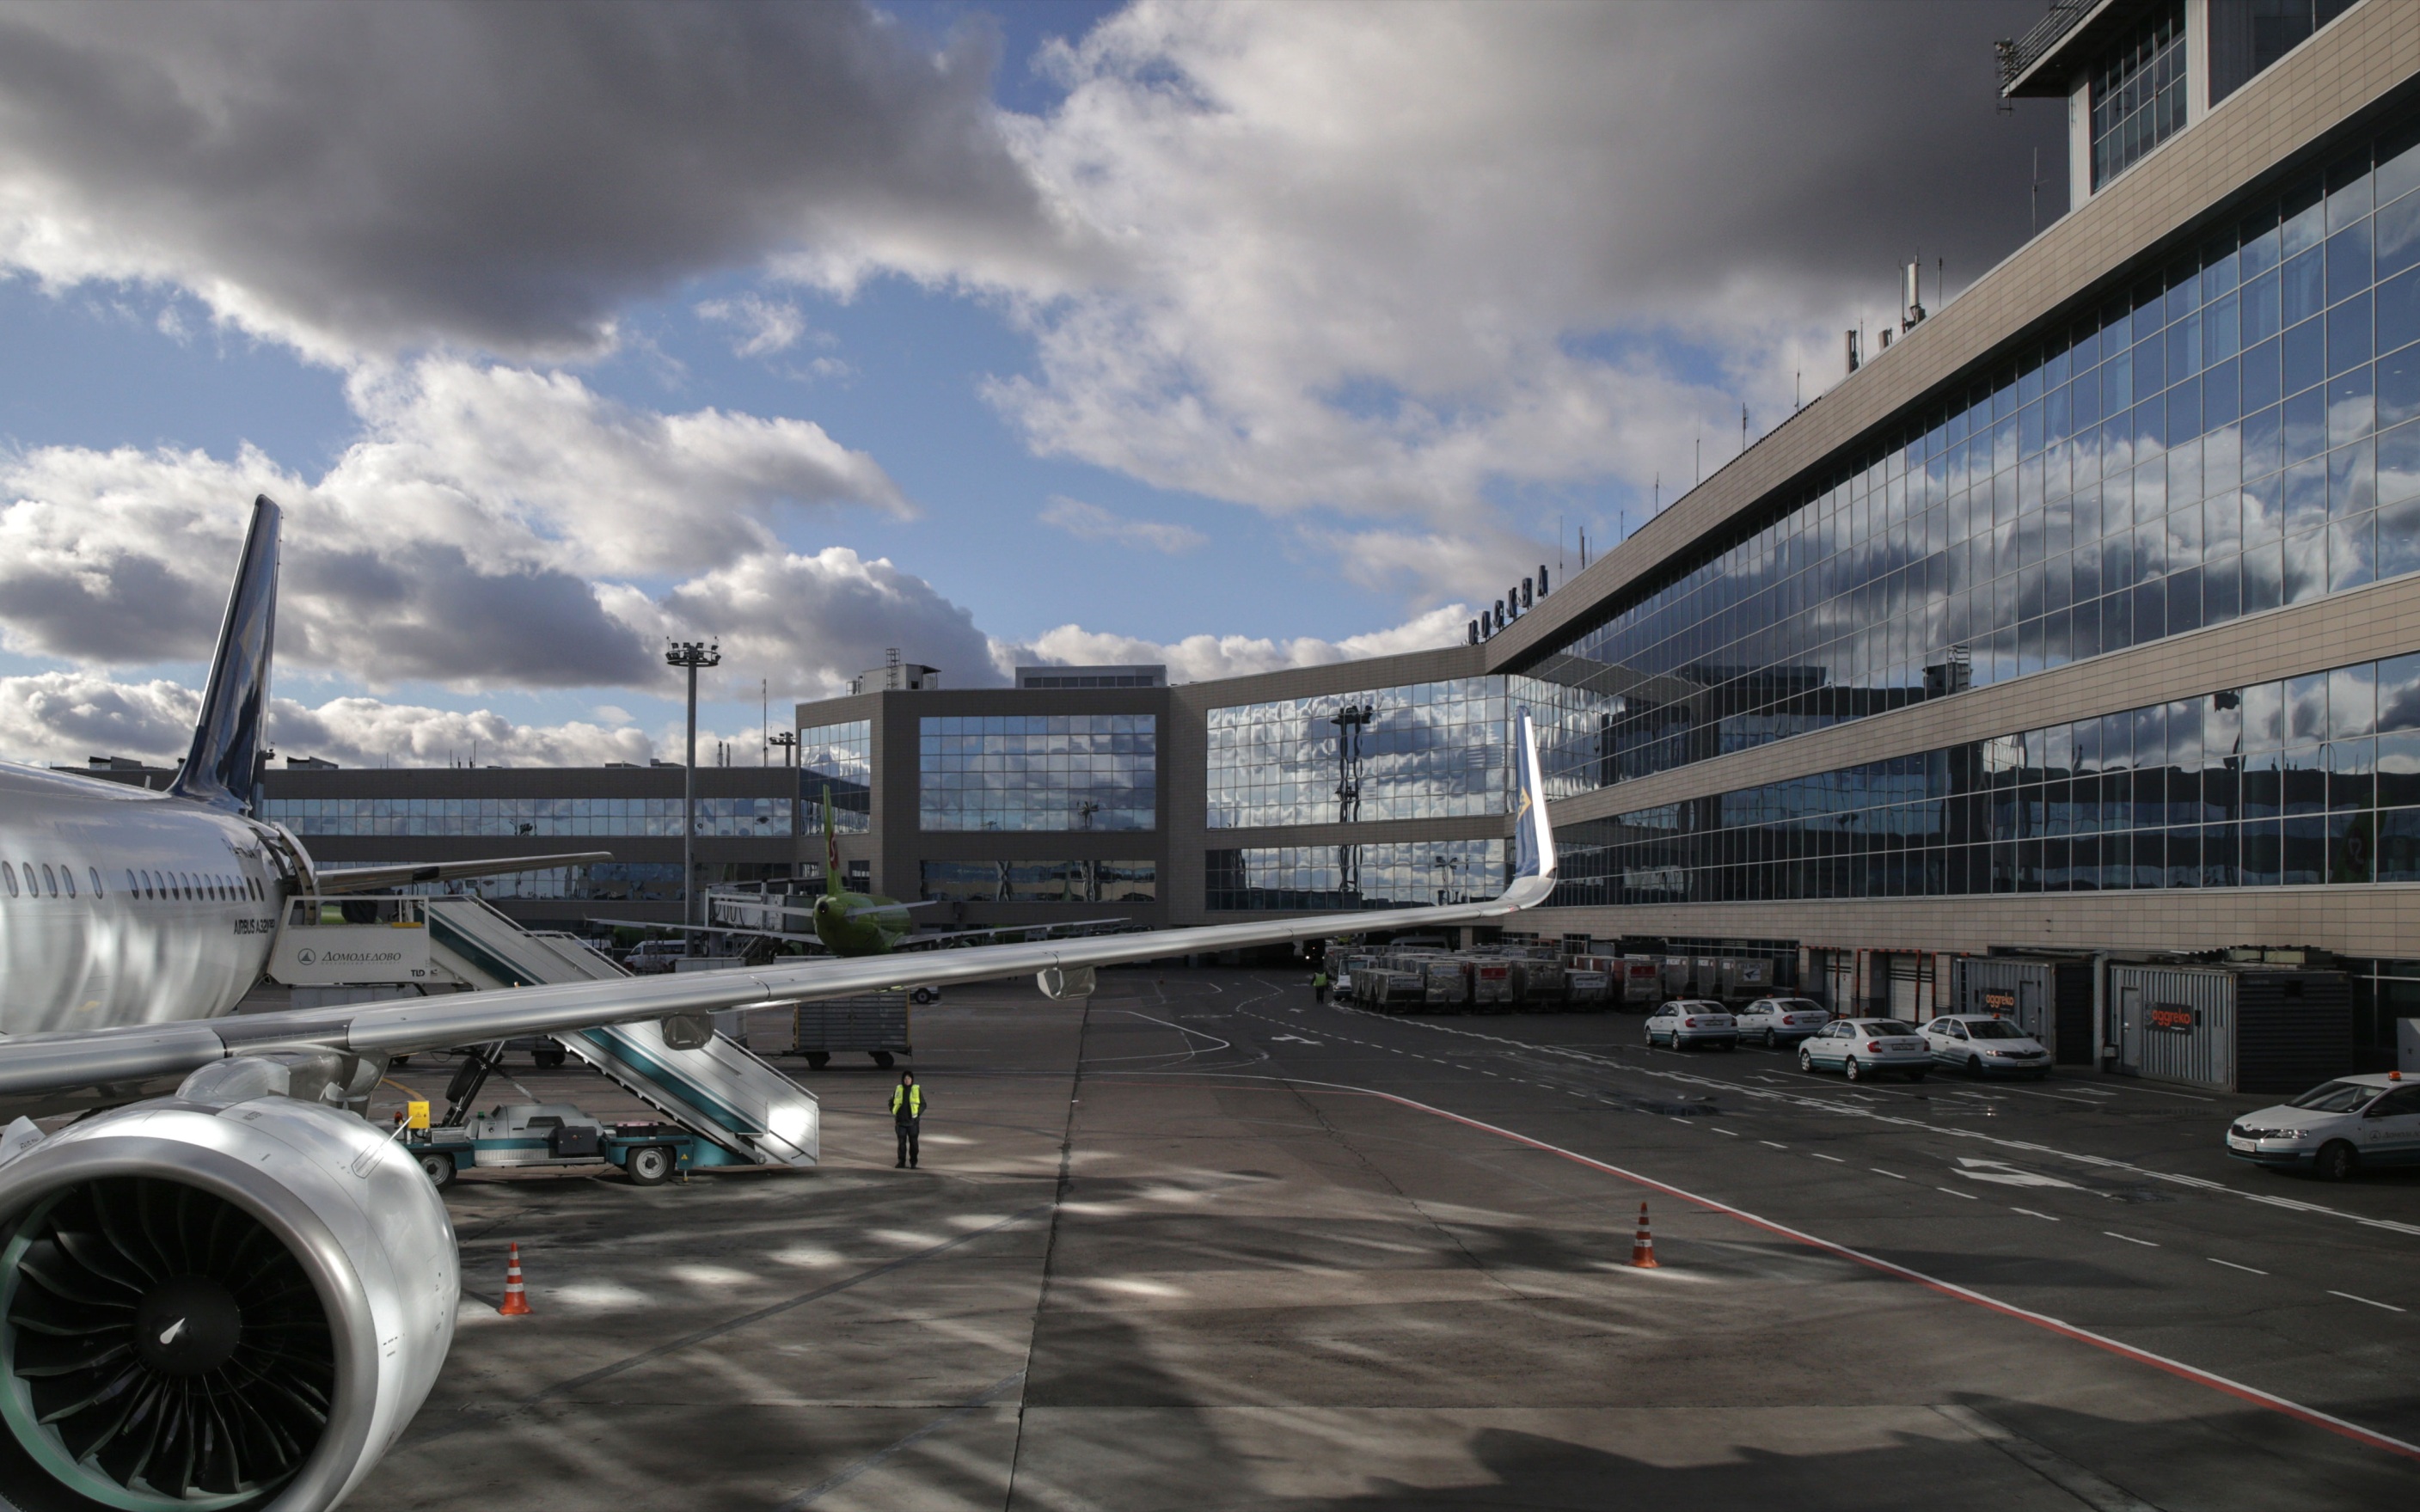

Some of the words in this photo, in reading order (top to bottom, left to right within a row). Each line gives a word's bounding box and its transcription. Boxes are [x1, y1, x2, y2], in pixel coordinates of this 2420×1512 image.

[234, 918, 255, 935] AIRBUS
[410, 969, 426, 977] TLD
[1985, 992, 2014, 1009] aggreko
[2152, 1007, 2191, 1027] aggreko
